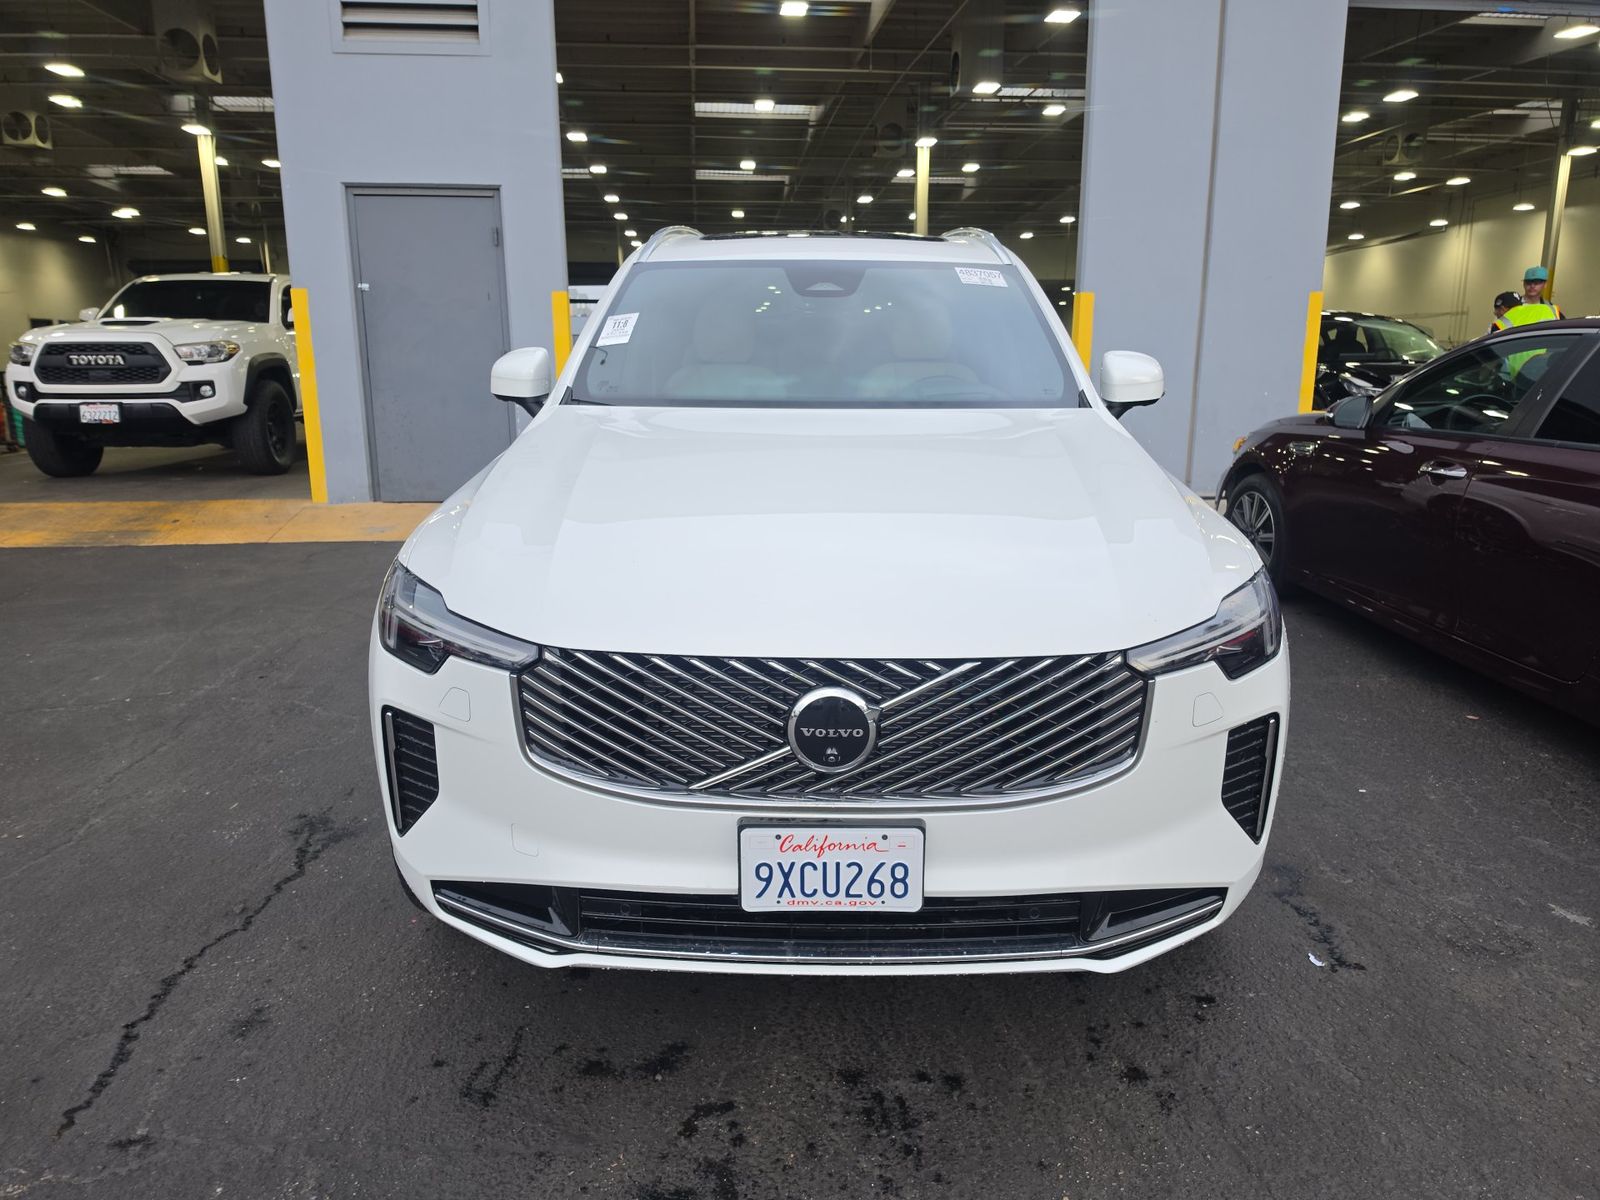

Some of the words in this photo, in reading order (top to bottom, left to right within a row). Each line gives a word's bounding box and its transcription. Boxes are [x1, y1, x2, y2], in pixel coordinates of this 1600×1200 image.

[69, 354, 125, 365] TOYOTA
[800, 727, 864, 738] VOLVO
[779, 834, 889, 858] California
[755, 861, 909, 899] 9XCU268
[787, 899, 877, 907] dmv.ca.gov
